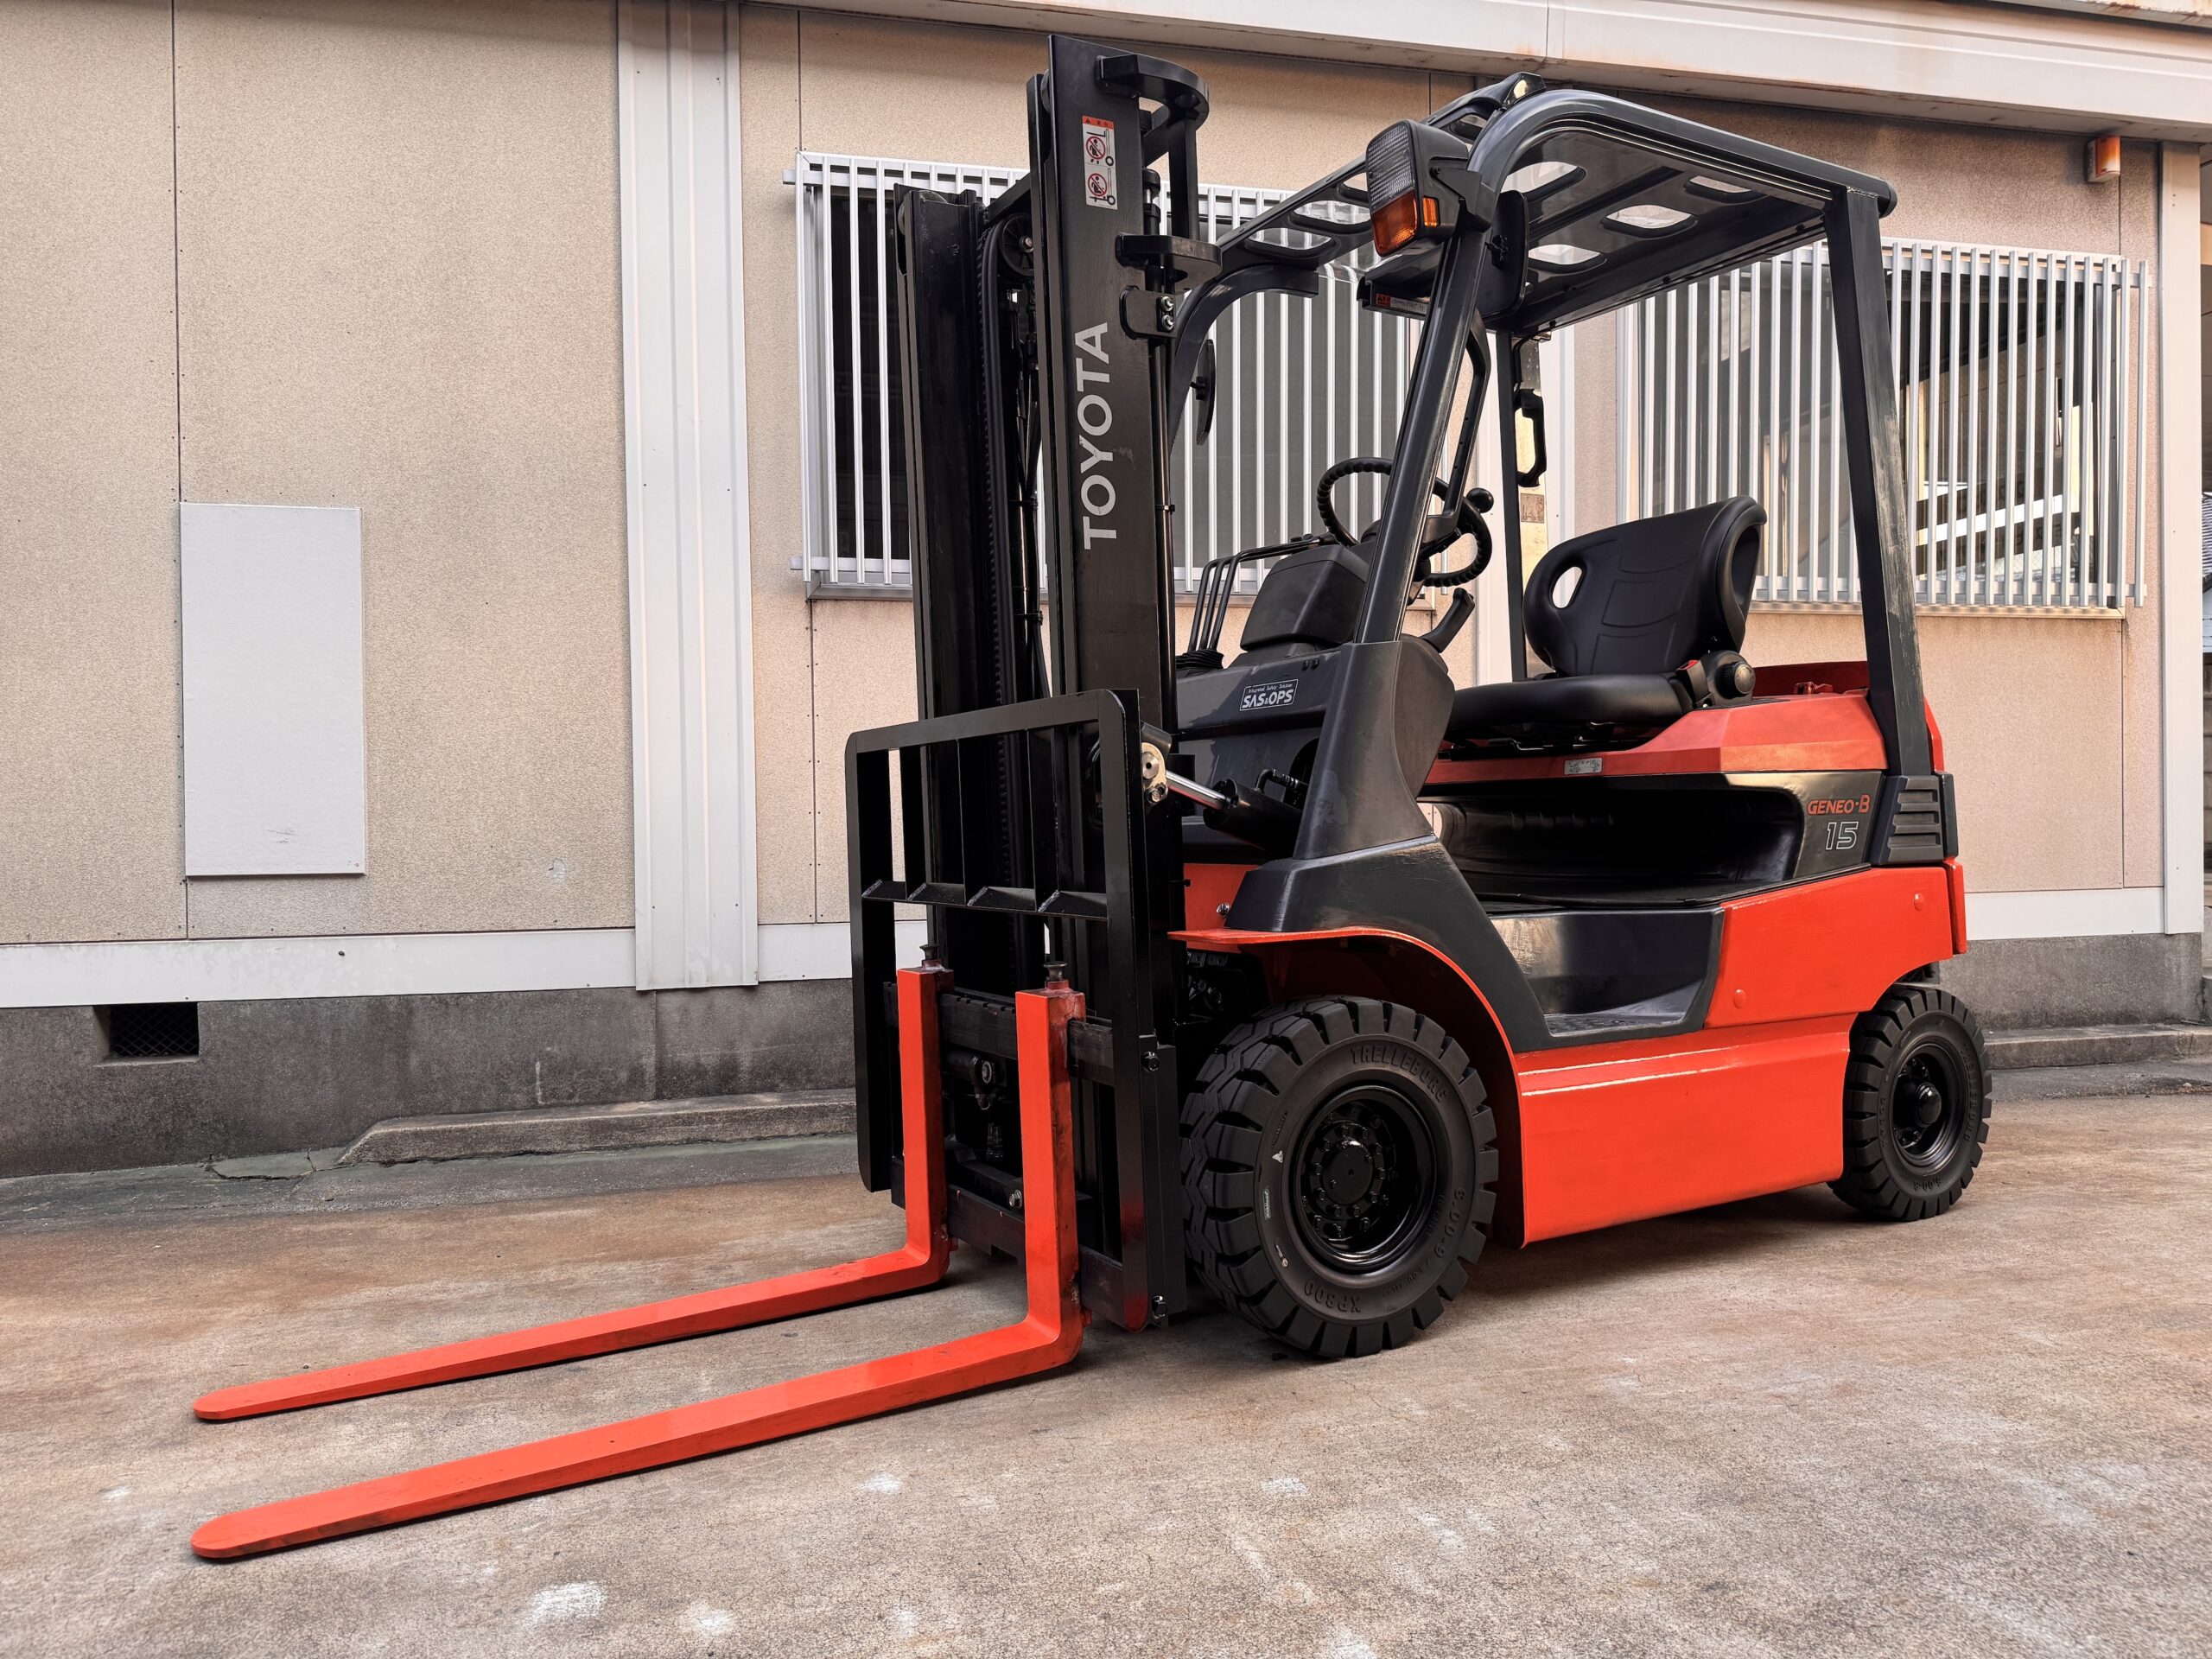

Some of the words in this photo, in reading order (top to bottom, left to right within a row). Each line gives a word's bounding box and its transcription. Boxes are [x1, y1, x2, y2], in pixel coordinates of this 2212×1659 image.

[1074, 321, 1117, 550] TOYOTA
[1825, 821, 1859, 850] 15
[1350, 1045, 1448, 1103] TRELLEBORG
